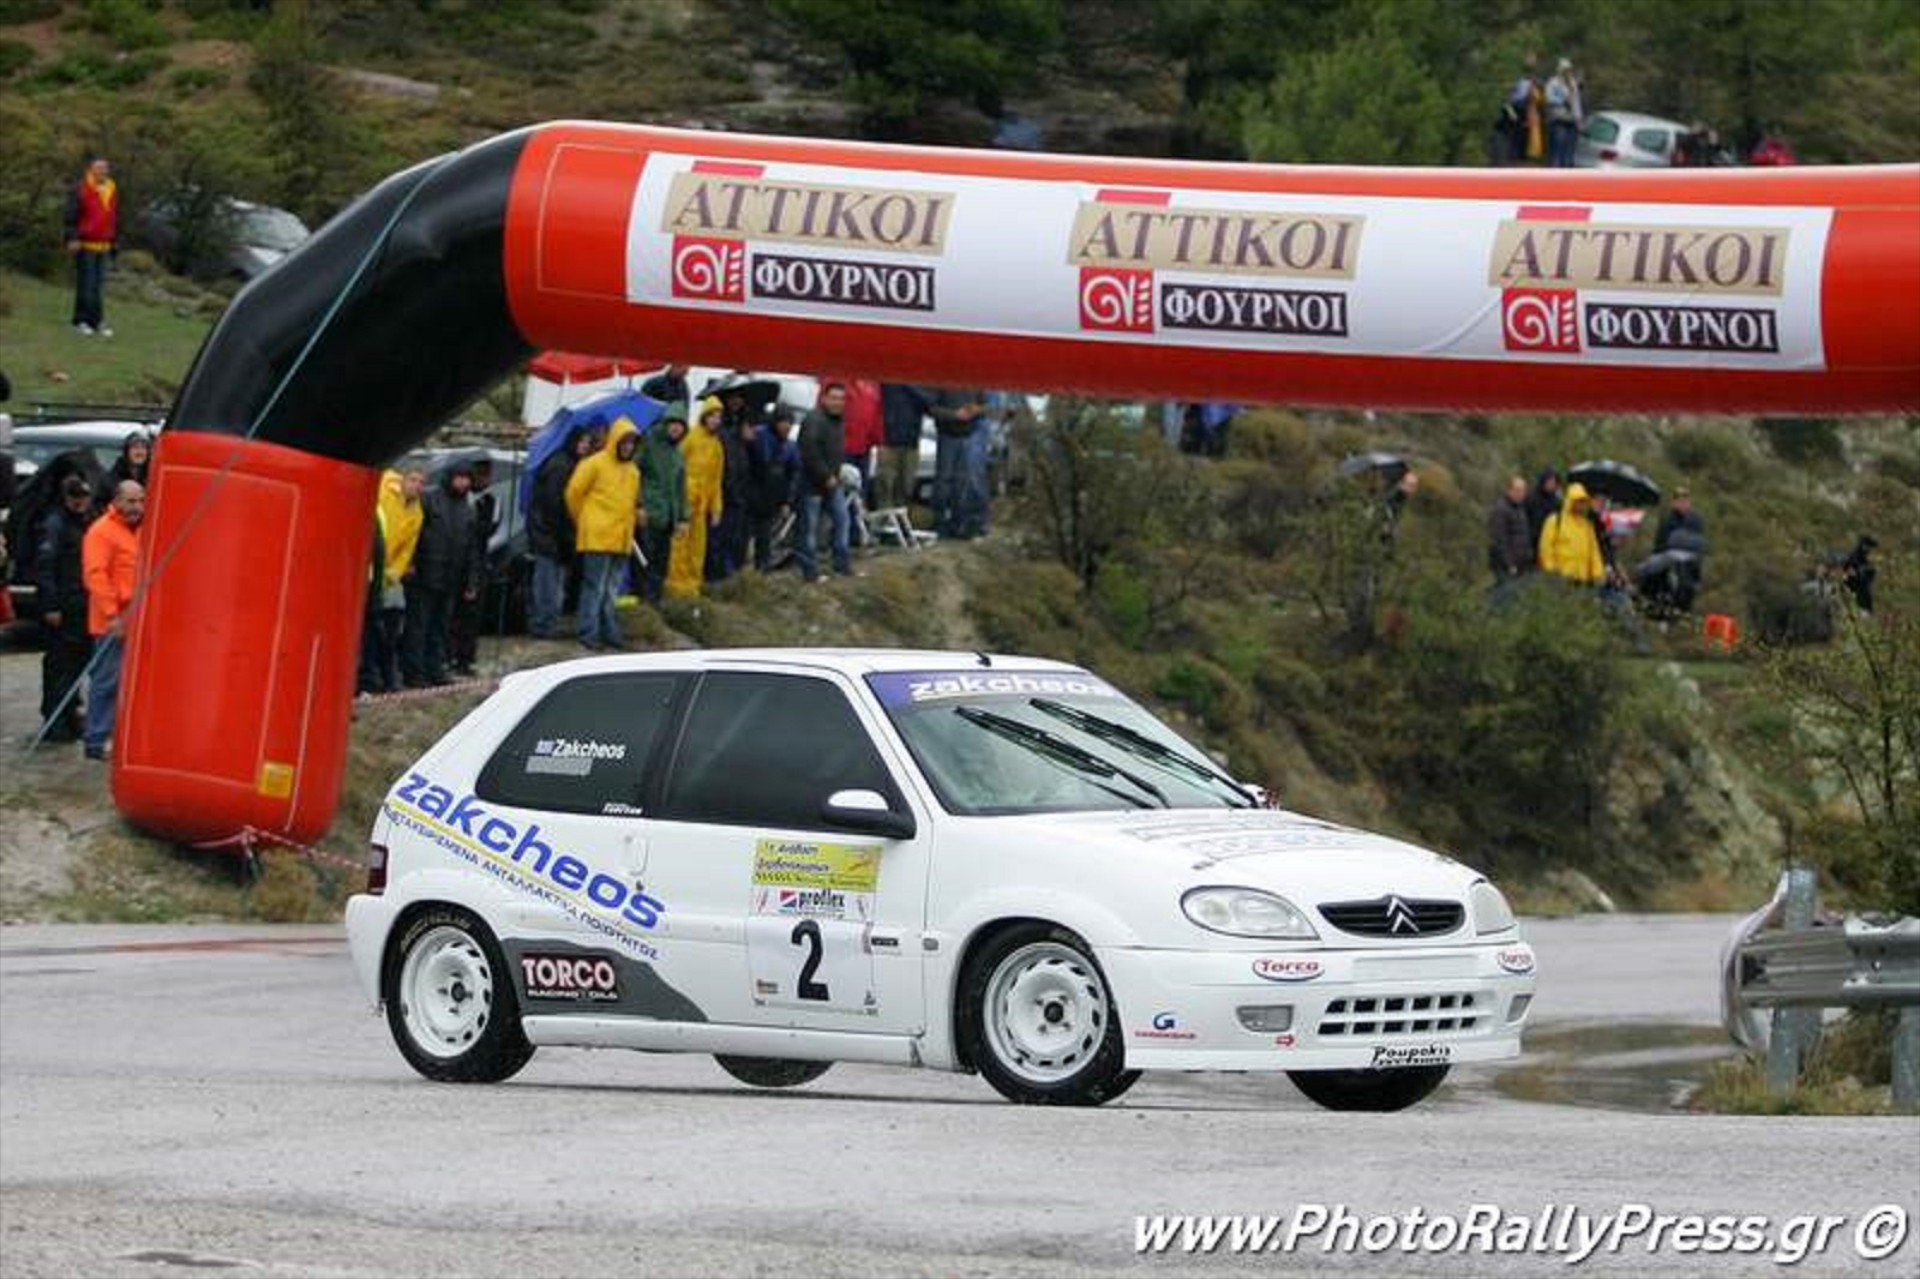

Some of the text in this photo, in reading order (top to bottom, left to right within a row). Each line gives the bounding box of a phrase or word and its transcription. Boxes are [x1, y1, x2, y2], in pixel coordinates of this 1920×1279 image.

[671, 179, 944, 250] ΑΤΤΙΚΟΙ
[1078, 209, 1352, 272] ΑΤΤΙΚΟΙ
[1500, 229, 1778, 287] ΑΤΤΙΚΟΙ
[754, 257, 935, 308] ΦΟΥΡΝΟΙ
[1164, 287, 1345, 332] ΦΟΥΡΝΟΙ
[1589, 306, 1775, 349] ΦΟΥΡΝΟΙ
[552, 738, 626, 759] Zakcheos
[395, 772, 665, 930] zakcheos
[798, 887, 845, 909] proflex
[521, 957, 616, 990] TORCO
[791, 919, 831, 1002] 2
